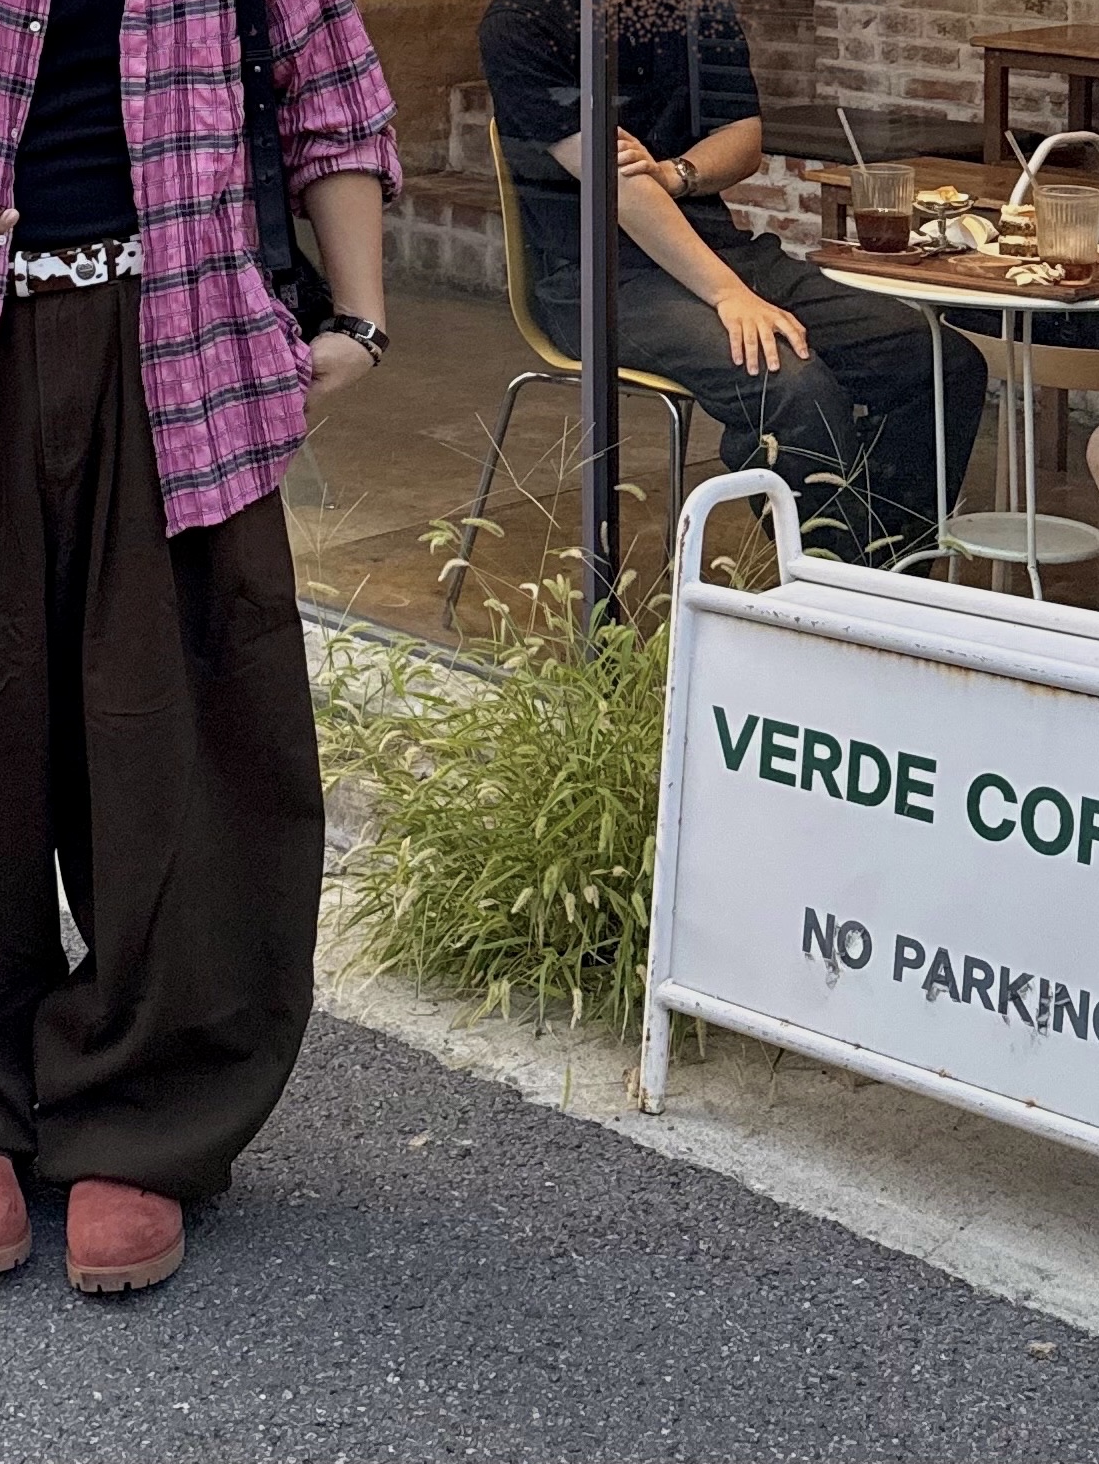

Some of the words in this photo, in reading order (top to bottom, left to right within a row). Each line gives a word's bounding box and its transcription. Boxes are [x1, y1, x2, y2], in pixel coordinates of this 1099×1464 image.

[712, 704, 938, 825] VERDE
[801, 906, 873, 971] NO
[893, 933, 1099, 1041] PARKIN
